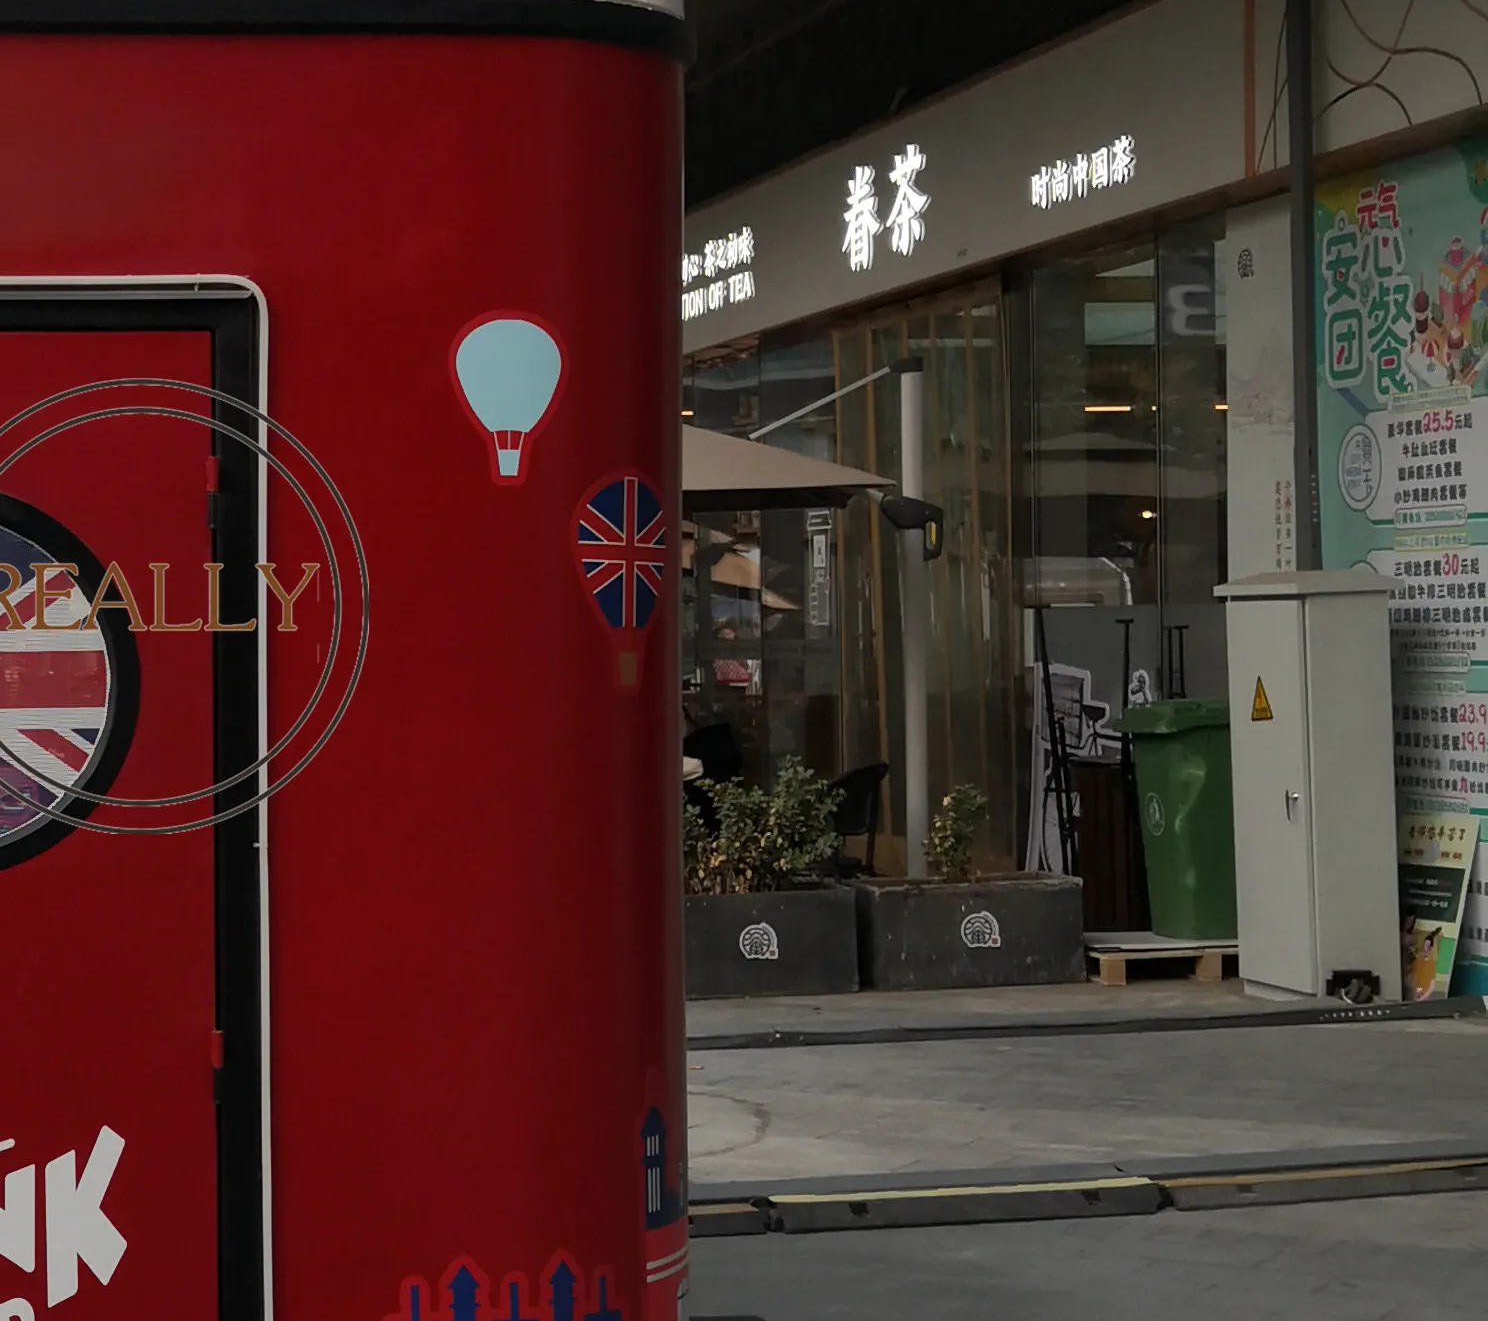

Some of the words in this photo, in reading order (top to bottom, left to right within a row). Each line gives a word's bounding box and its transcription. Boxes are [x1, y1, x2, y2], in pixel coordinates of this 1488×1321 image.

[1030, 135, 1135, 210] 时尚中国茶
[728, 271, 755, 304] TEA
